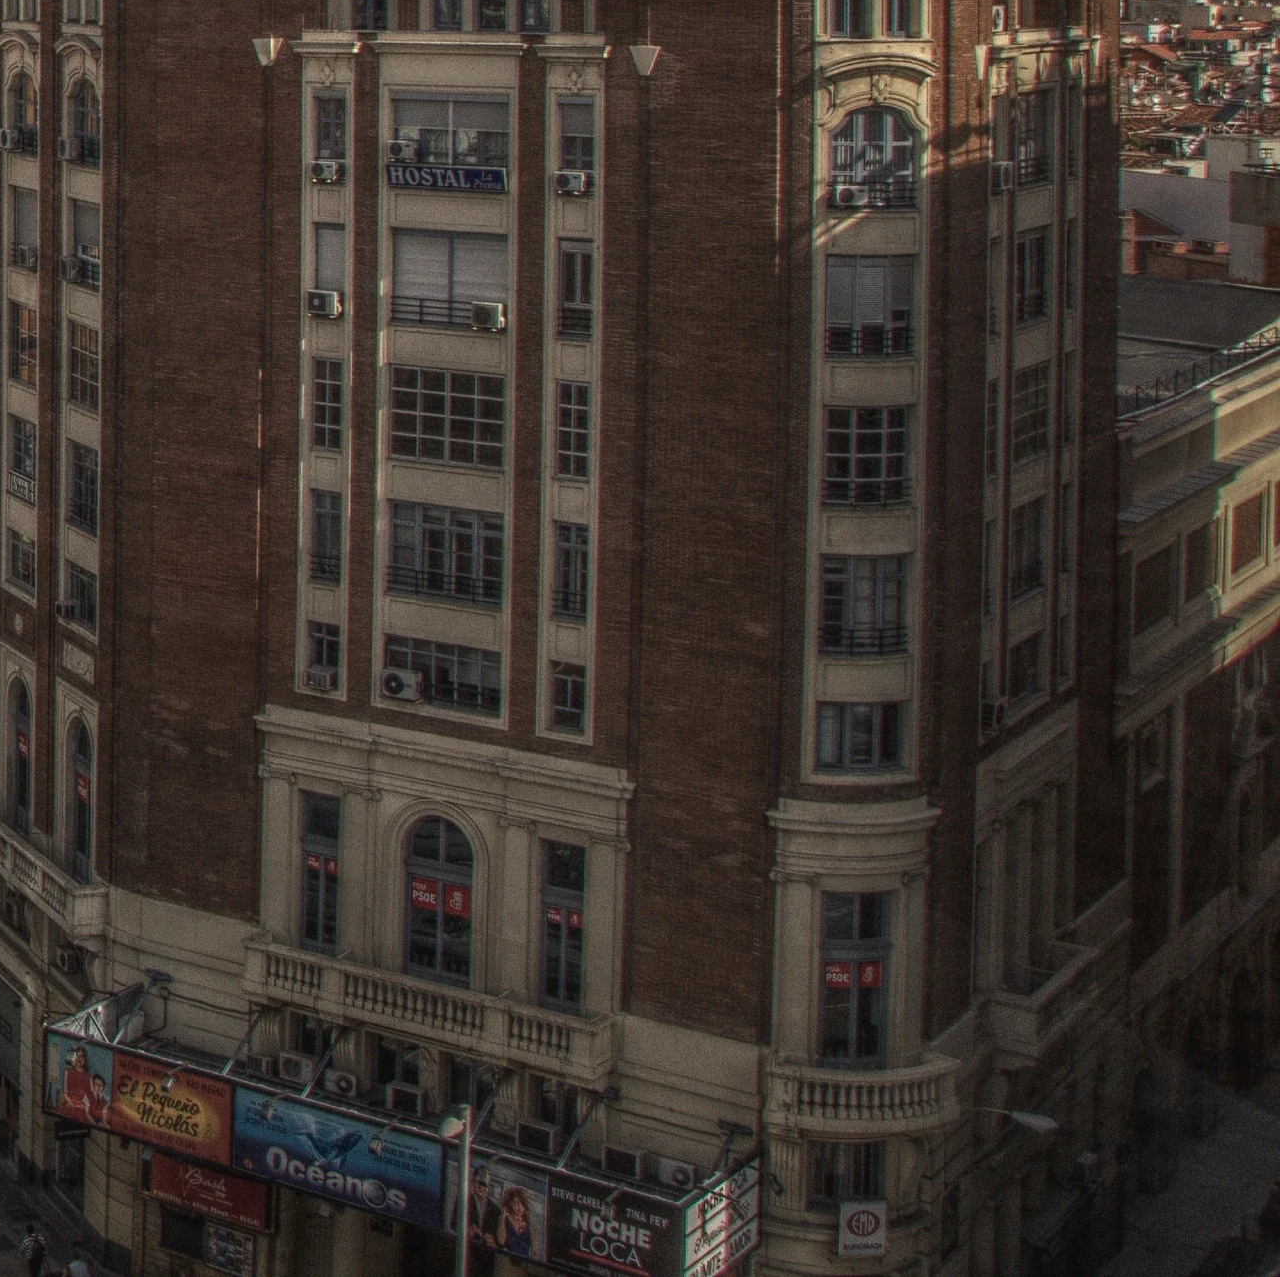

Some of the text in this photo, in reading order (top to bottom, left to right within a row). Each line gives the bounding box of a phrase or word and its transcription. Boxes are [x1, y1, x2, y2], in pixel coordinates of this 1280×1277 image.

[390, 166, 470, 188] HOSTAL
[412, 889, 437, 904] PSOE
[826, 972, 850, 983] PSOE
[117, 1074, 139, 1097] El
[141, 1080, 200, 1116] Pequeño
[136, 1102, 200, 1137] Nicolás
[184, 1168, 227, 1192] Bash
[551, 1186, 575, 1202] STEVE
[625, 1207, 646, 1222] TINA
[649, 1214, 671, 1229] FEY
[571, 1206, 653, 1251] NOCHE
[579, 1230, 643, 1268] LOCA
